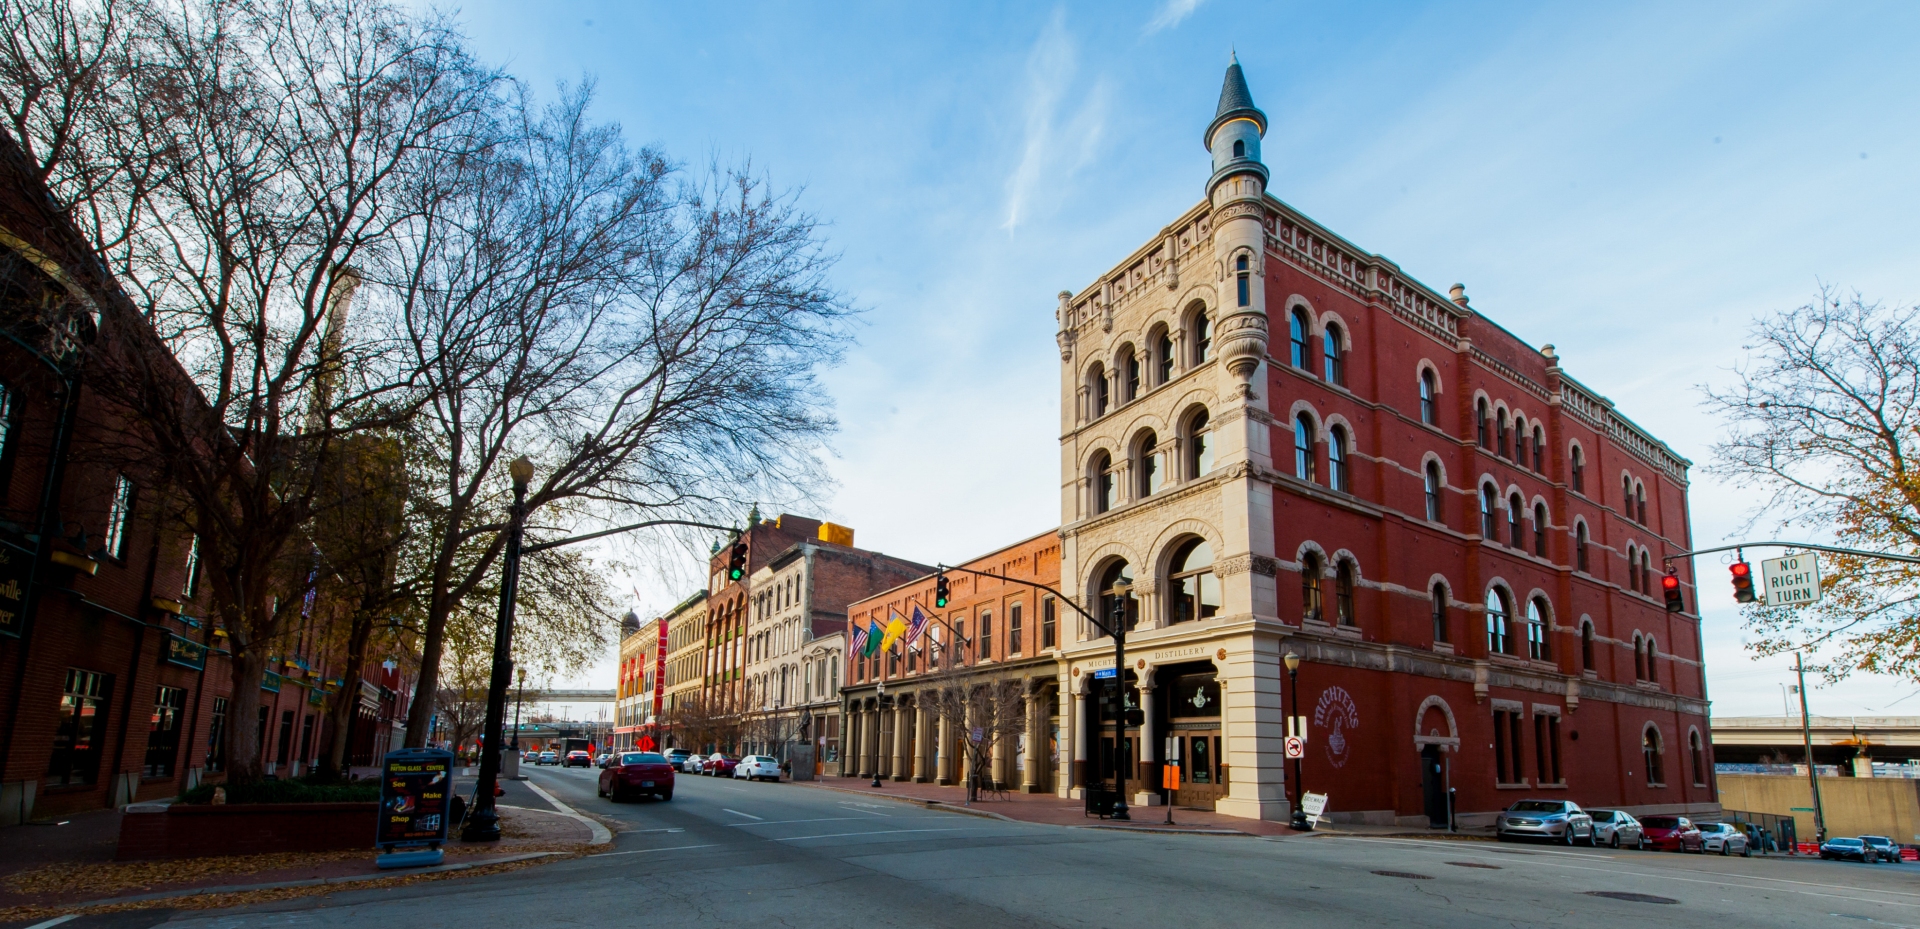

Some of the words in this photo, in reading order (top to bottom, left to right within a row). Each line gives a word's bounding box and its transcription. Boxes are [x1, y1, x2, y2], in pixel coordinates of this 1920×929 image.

[1780, 558, 1798, 571] NO
[1771, 572, 1810, 588] RIGHT
[1776, 588, 1810, 602] TURN
[1088, 657, 1128, 668] MICHTES
[1155, 646, 1206, 659] DISTILLERY
[1314, 685, 1359, 729] MICHTER'S
[1304, 796, 1324, 804] SIDEWALK
